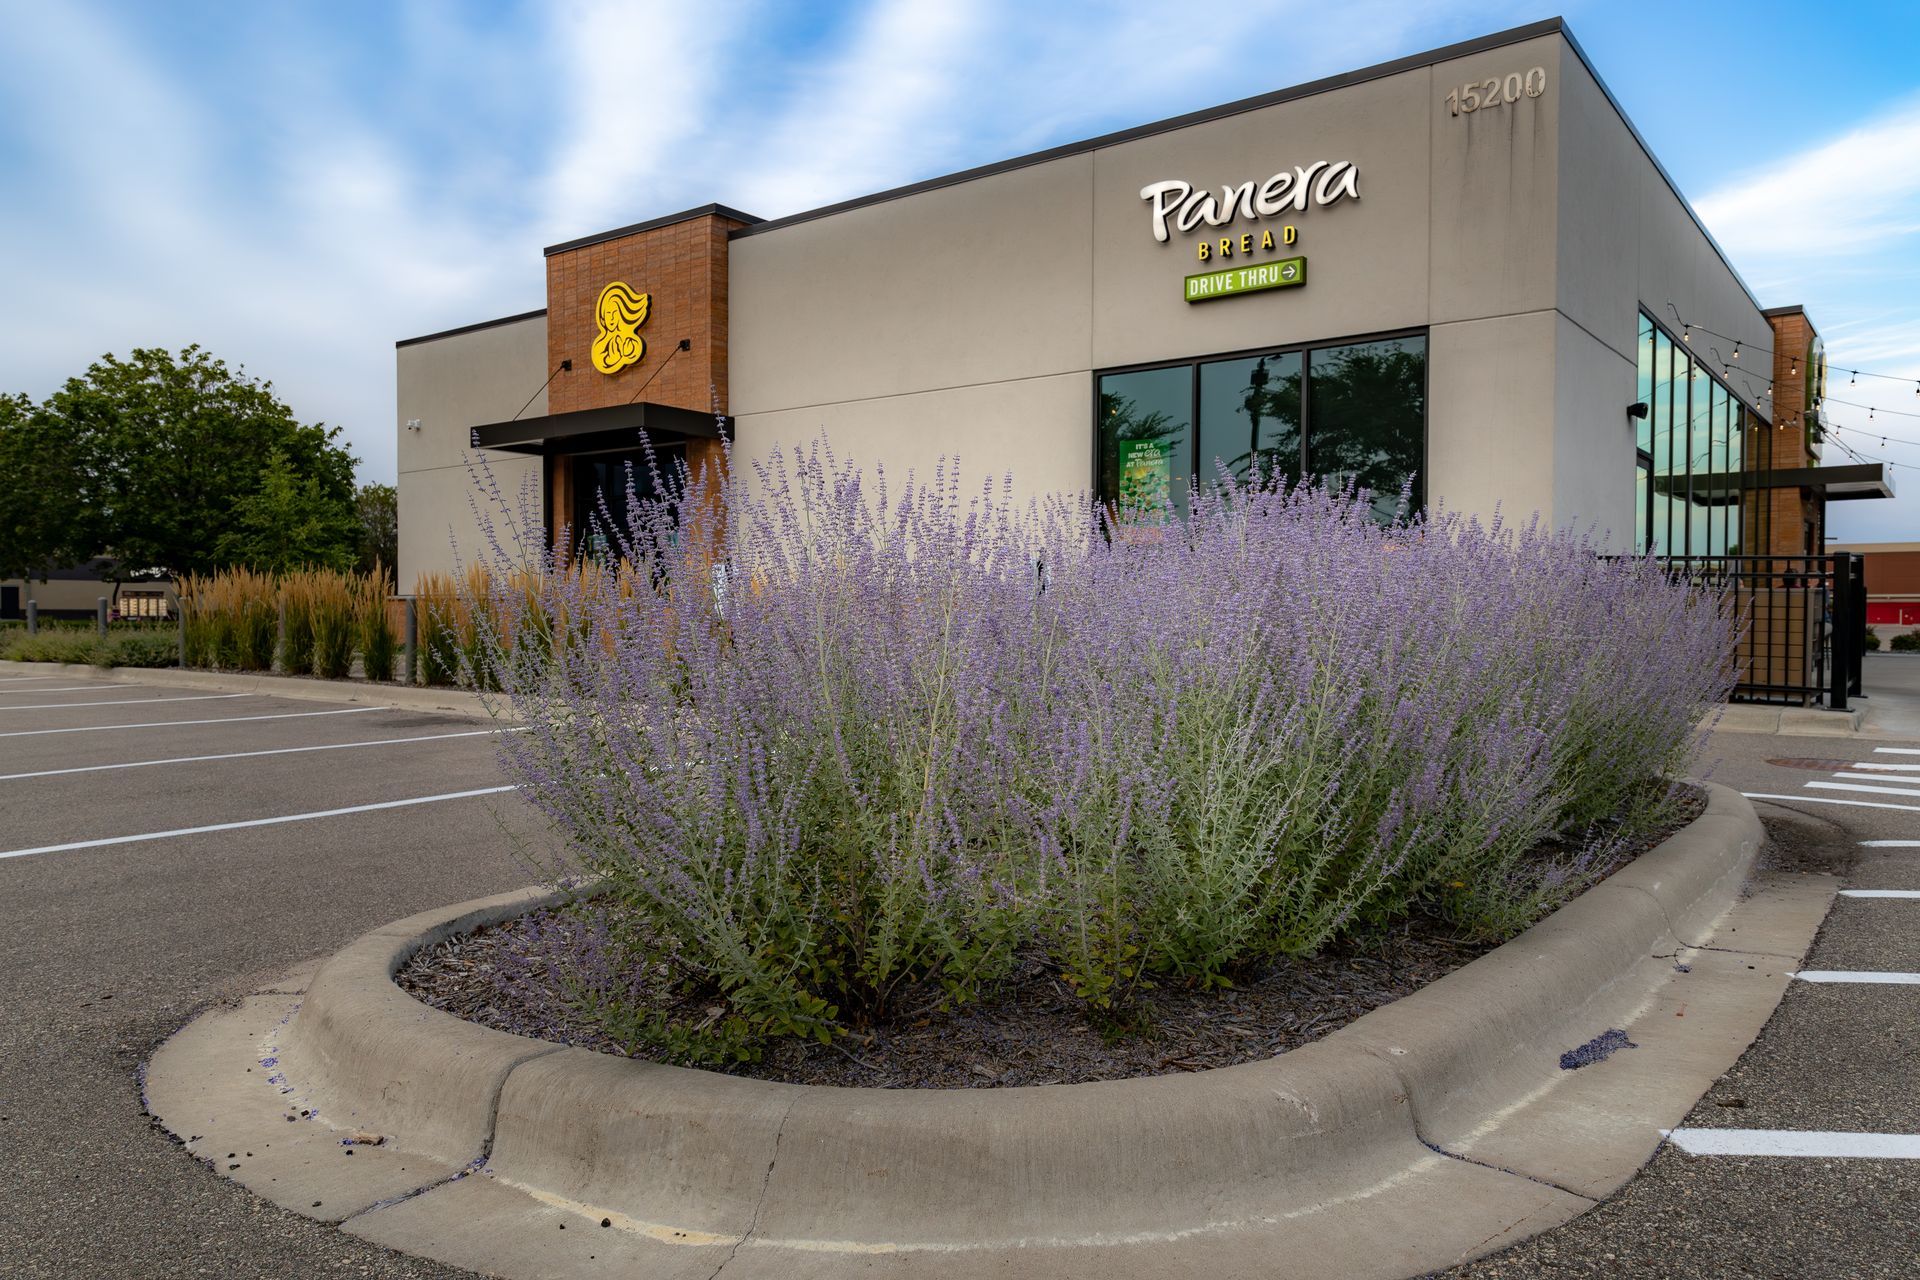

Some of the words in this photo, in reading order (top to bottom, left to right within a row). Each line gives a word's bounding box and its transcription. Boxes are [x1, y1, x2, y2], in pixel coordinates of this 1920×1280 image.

[1444, 66, 1546, 117] 15200
[1139, 160, 1360, 242] Panera
[1198, 225, 1298, 262] BREAD
[1189, 273, 1233, 297] DRIVE
[1239, 265, 1279, 288] THRU
[1135, 458, 1163, 467] Panera
